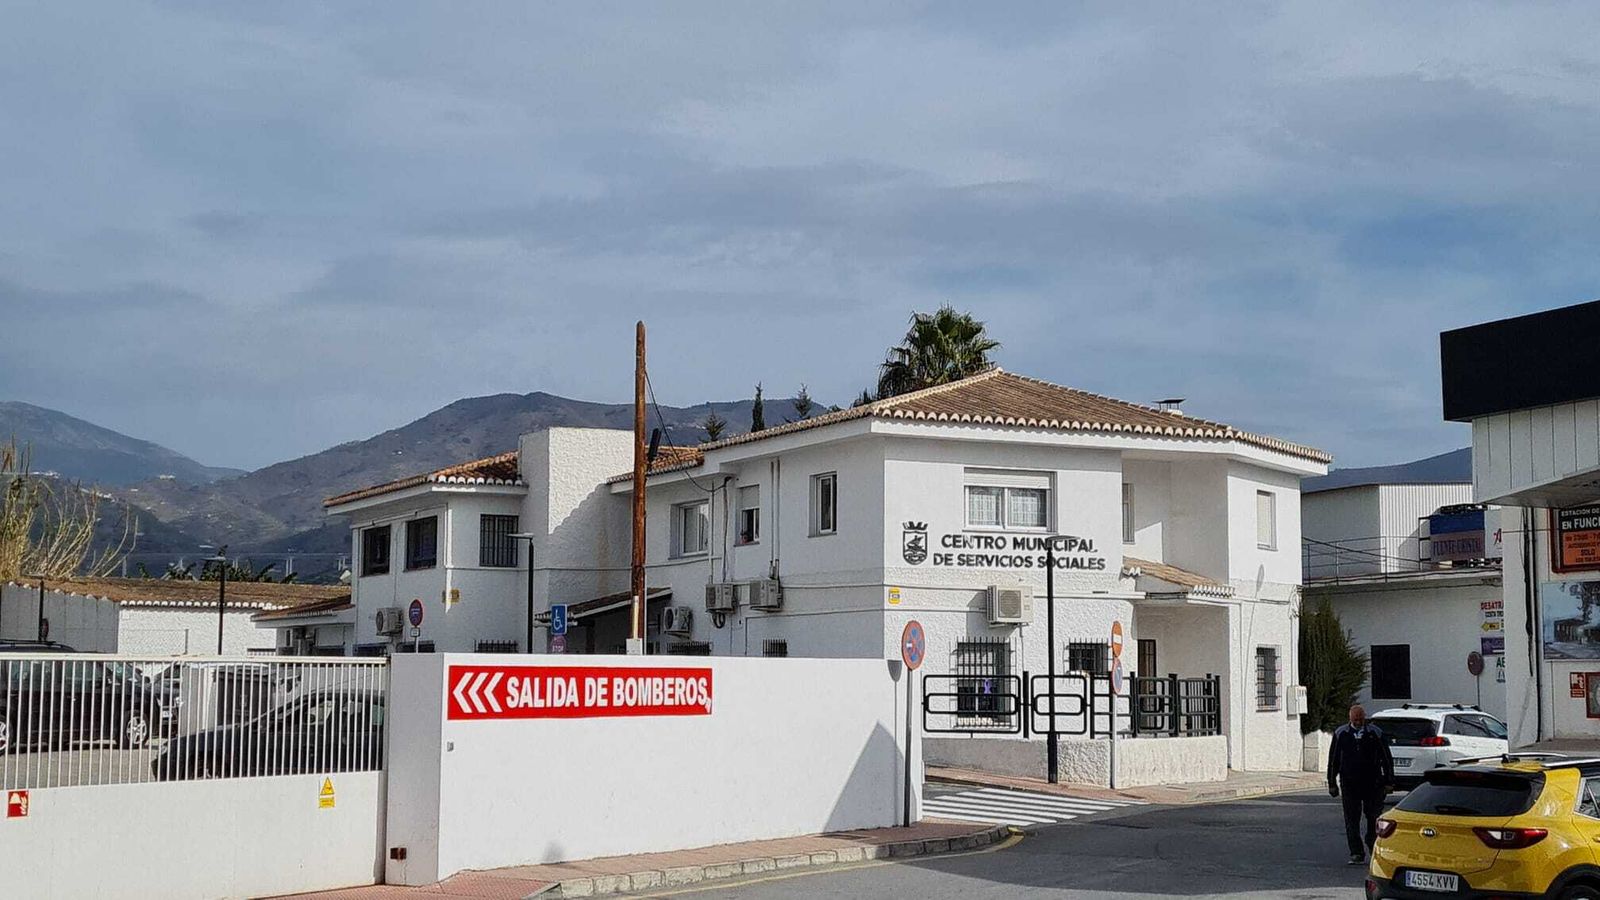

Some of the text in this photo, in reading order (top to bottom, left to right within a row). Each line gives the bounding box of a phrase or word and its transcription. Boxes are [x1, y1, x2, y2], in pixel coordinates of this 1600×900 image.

[1562, 521, 1572, 530] EN
[941, 534, 1007, 550] CENTRO
[933, 553, 954, 566] DE
[957, 554, 1034, 569] SERVICIOS
[506, 676, 709, 709] SALIDA DE BOMBEROS
[1411, 872, 1456, 890] 4554 KVV
